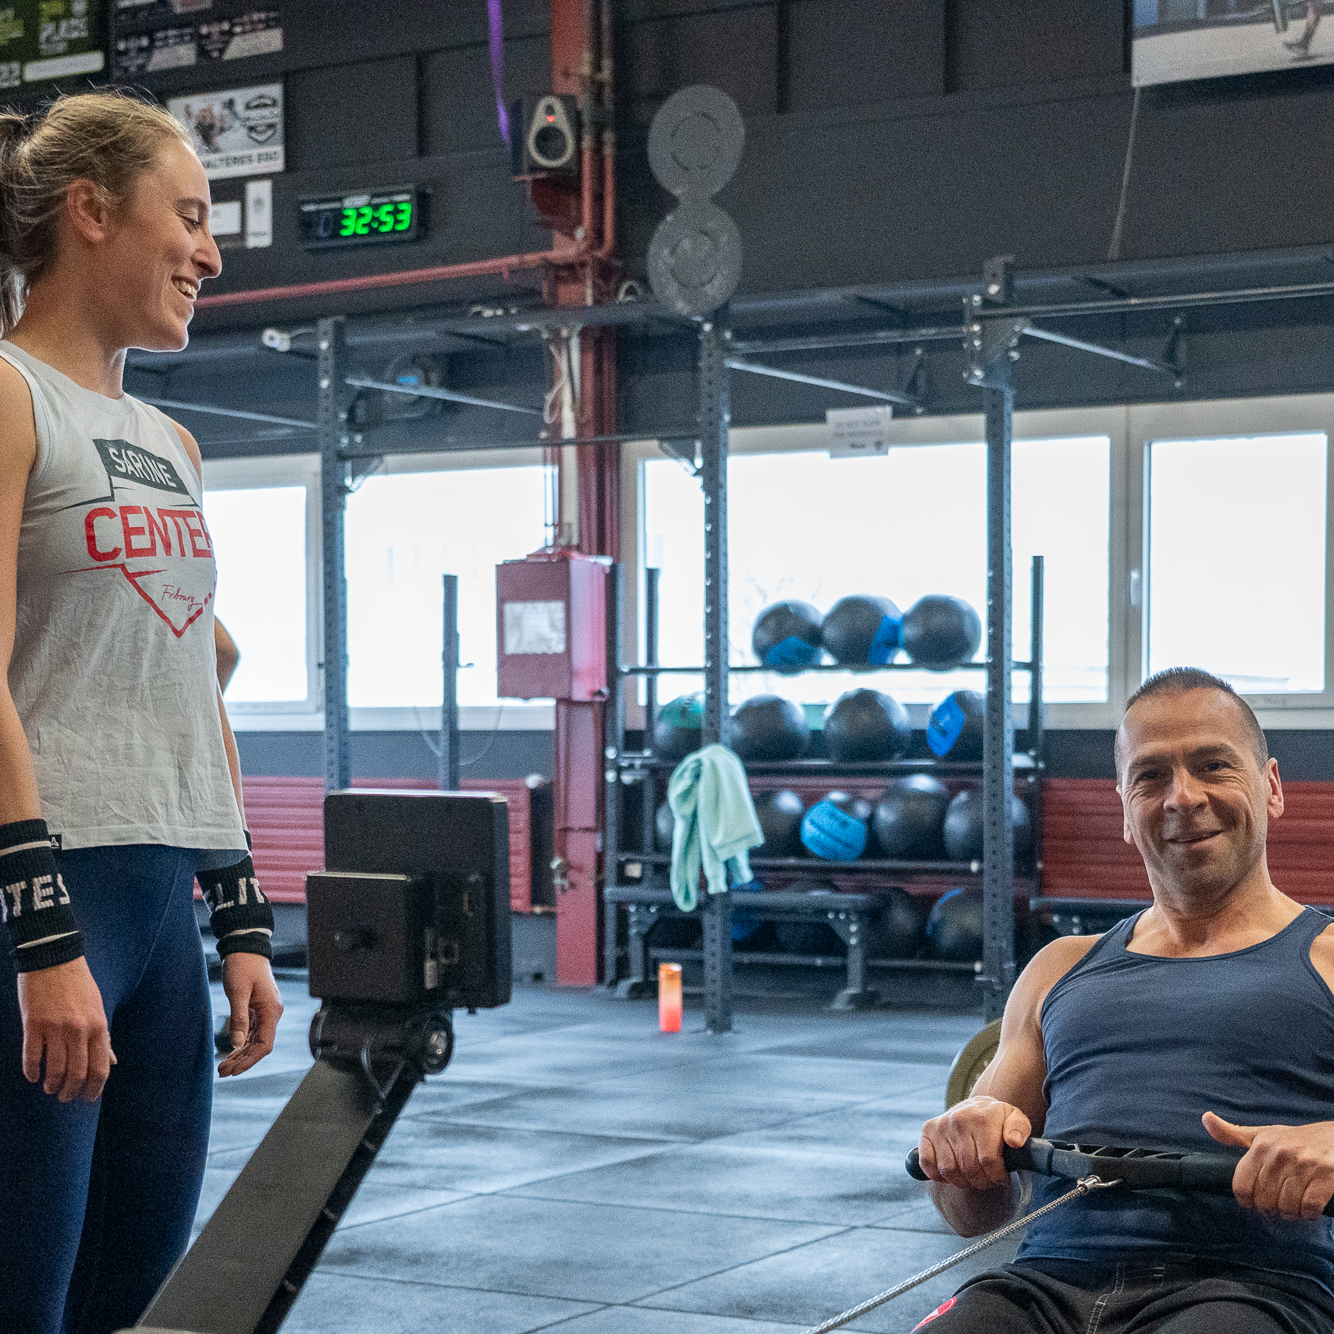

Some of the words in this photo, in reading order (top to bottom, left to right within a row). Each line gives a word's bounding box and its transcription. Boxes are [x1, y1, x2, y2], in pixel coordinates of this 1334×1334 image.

[339, 202, 412, 237] 32:53
[109, 446, 179, 489] SARINE
[161, 583, 204, 610] Fribourg
